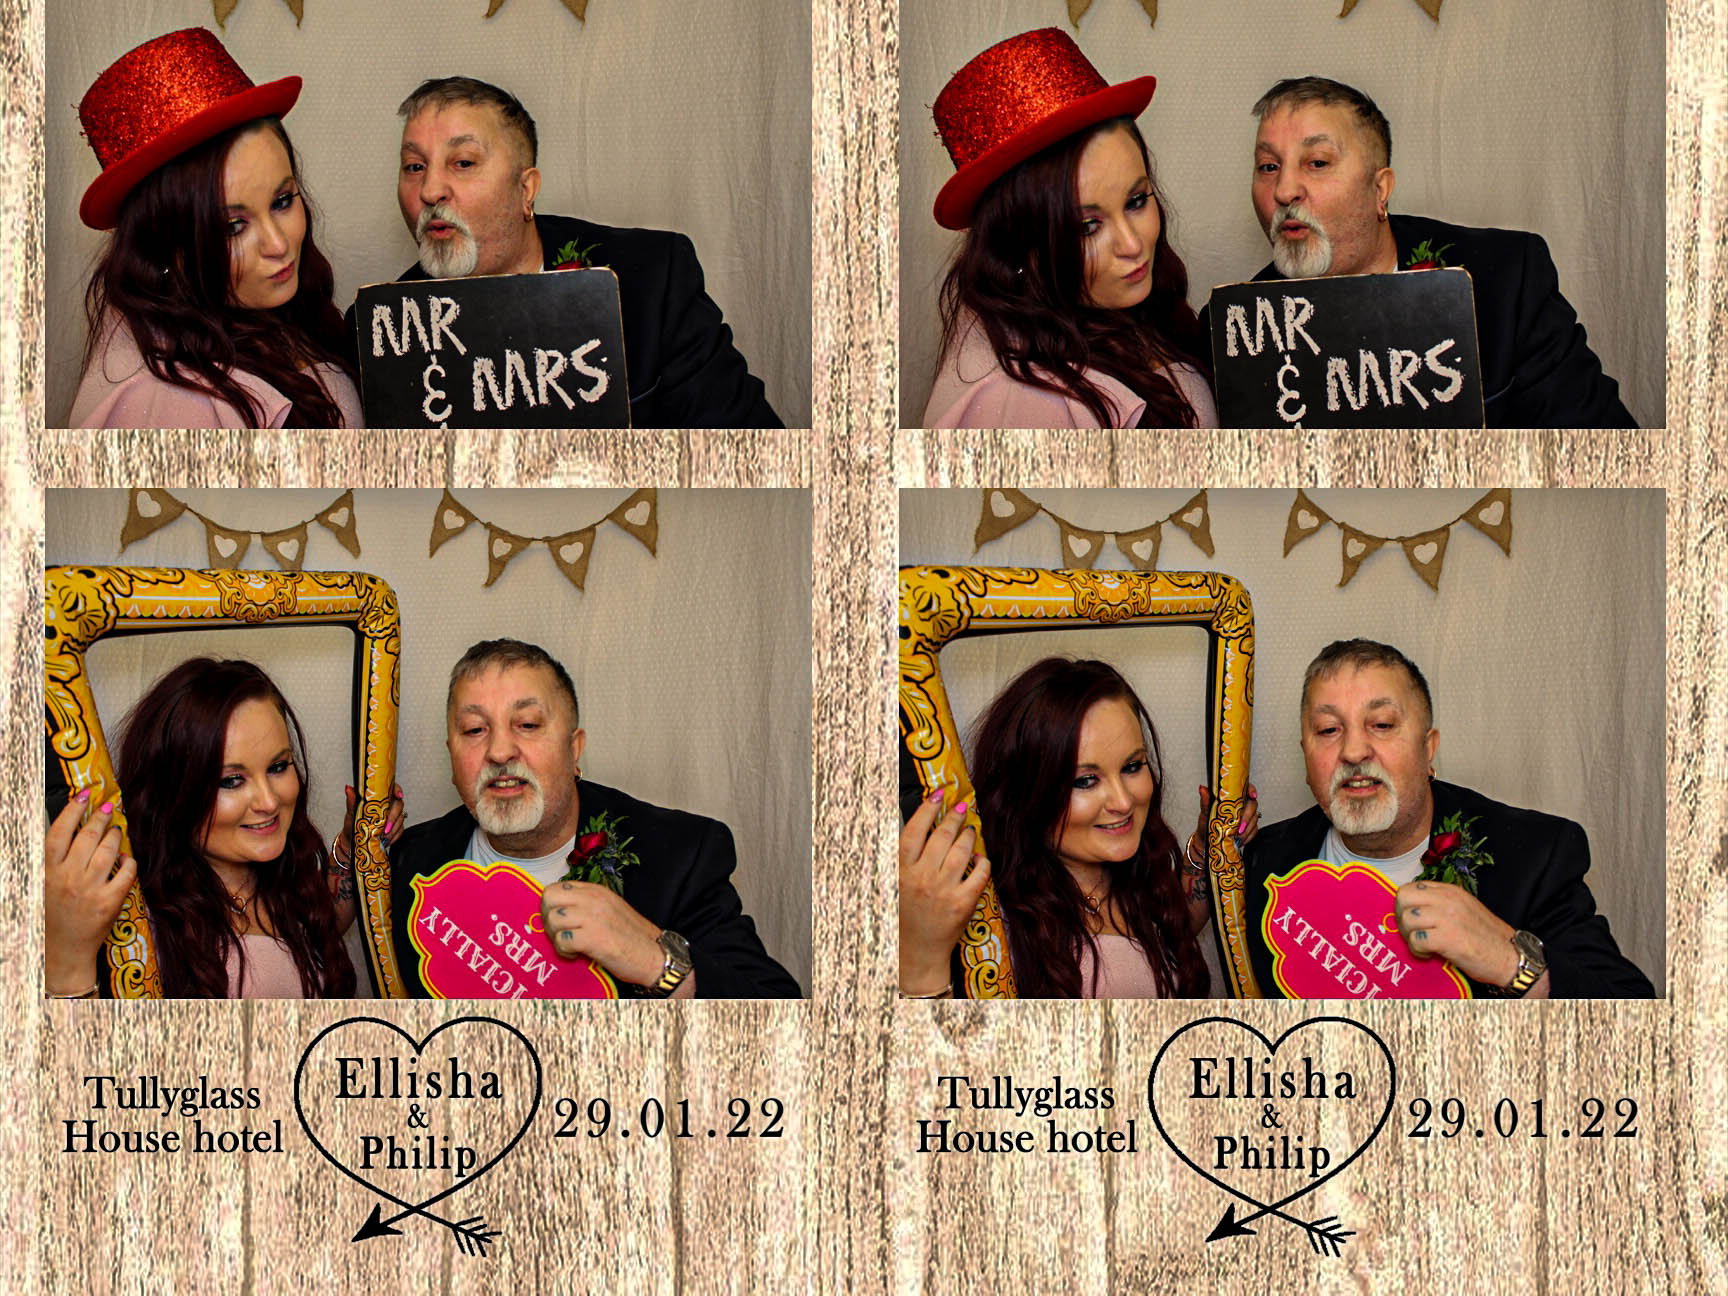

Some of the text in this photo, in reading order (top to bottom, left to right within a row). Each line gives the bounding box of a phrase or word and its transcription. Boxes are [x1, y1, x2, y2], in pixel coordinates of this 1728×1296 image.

[372, 294, 467, 358] MR
[1226, 294, 1321, 358] MR
[419, 906, 532, 999] ICIALLY
[487, 913, 558, 987] MRS.
[1273, 906, 1386, 999] ICIALLY
[1341, 913, 1412, 987] MRS.
